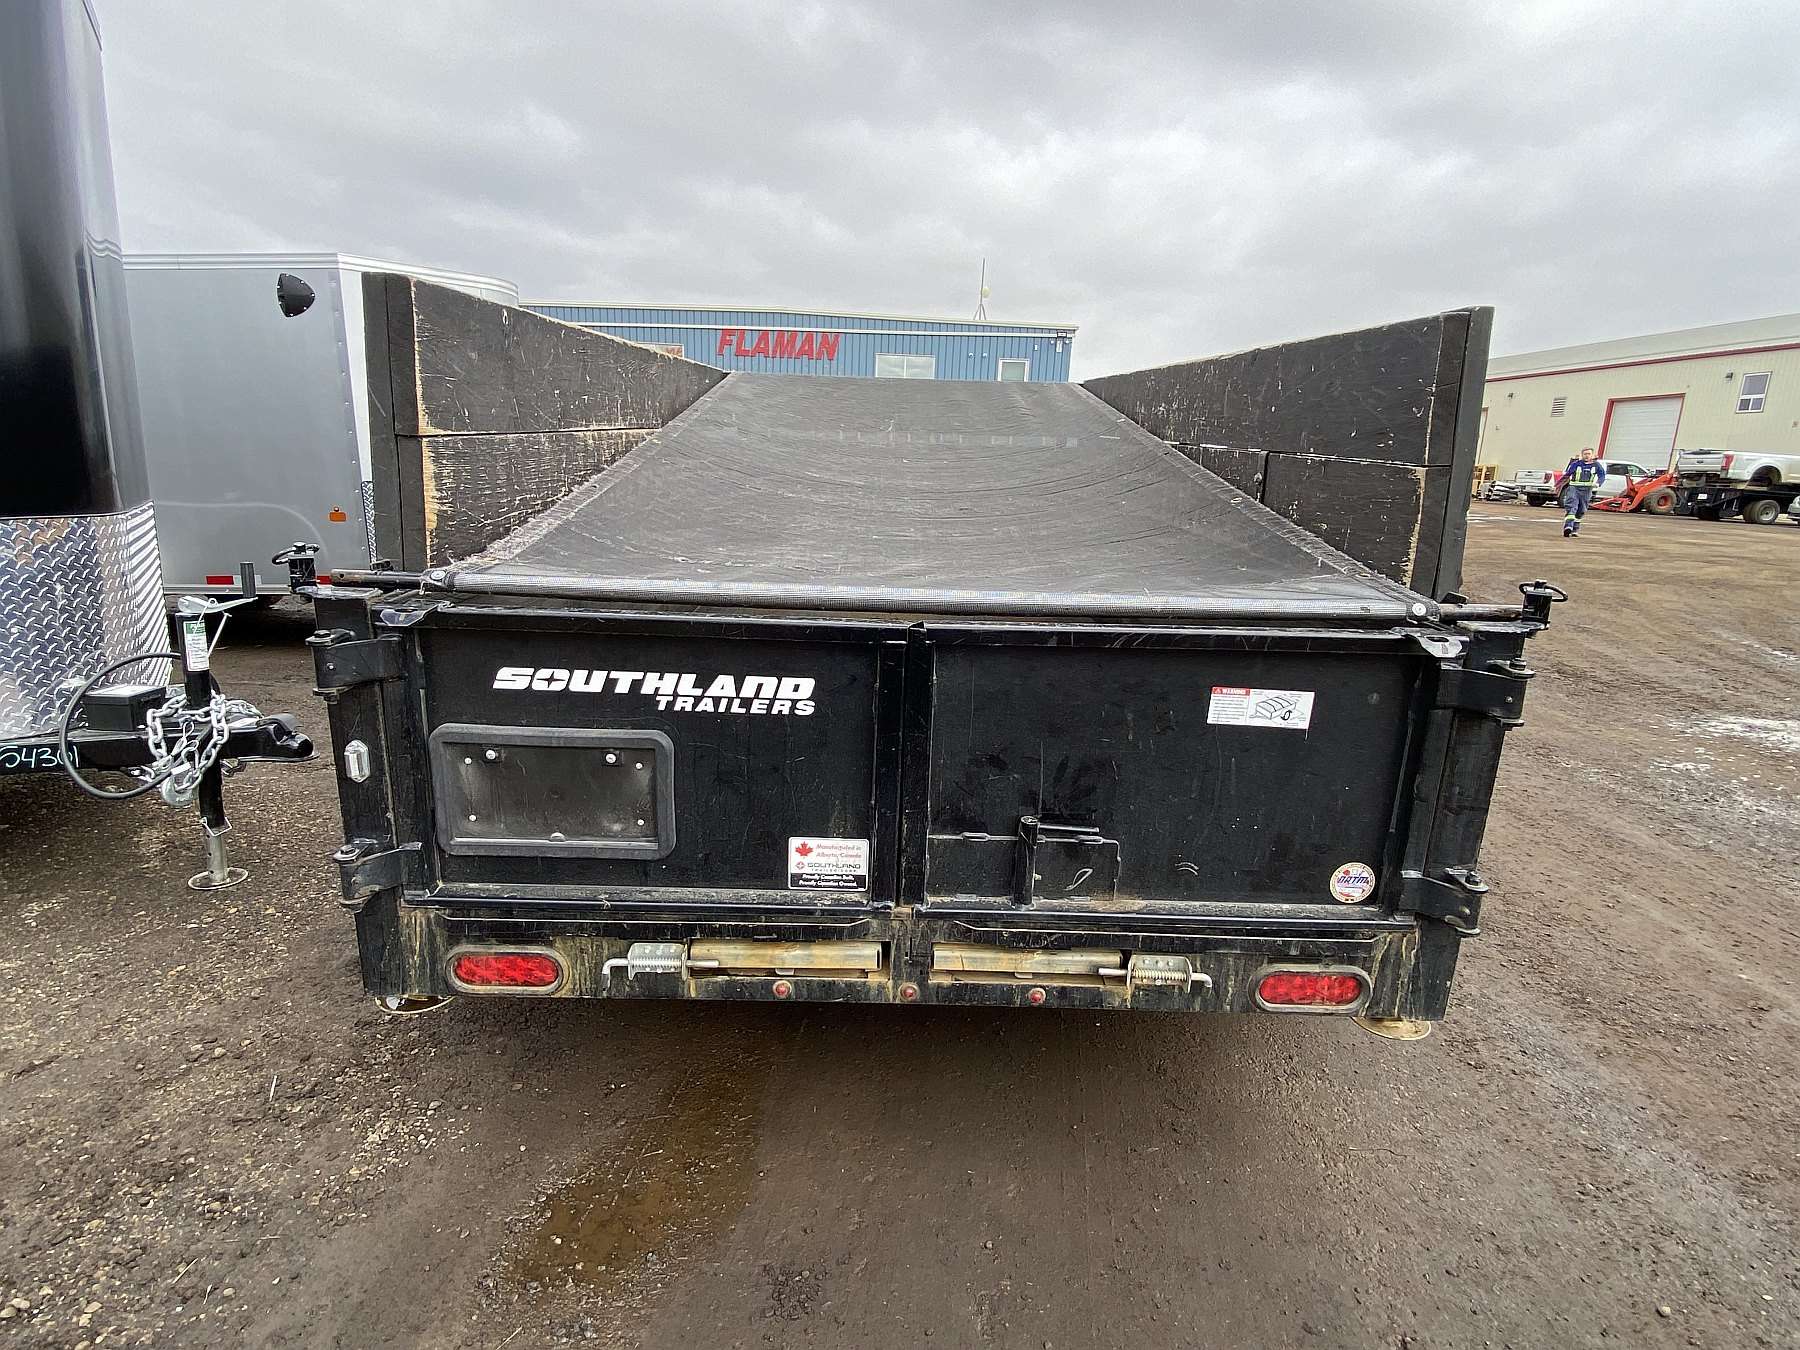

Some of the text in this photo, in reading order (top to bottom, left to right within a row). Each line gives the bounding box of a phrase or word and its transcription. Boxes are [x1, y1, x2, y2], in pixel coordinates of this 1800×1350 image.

[717, 328, 840, 361] FLAMAN
[492, 666, 816, 700] SOUTHLAND
[655, 696, 816, 716] TRAILERS
